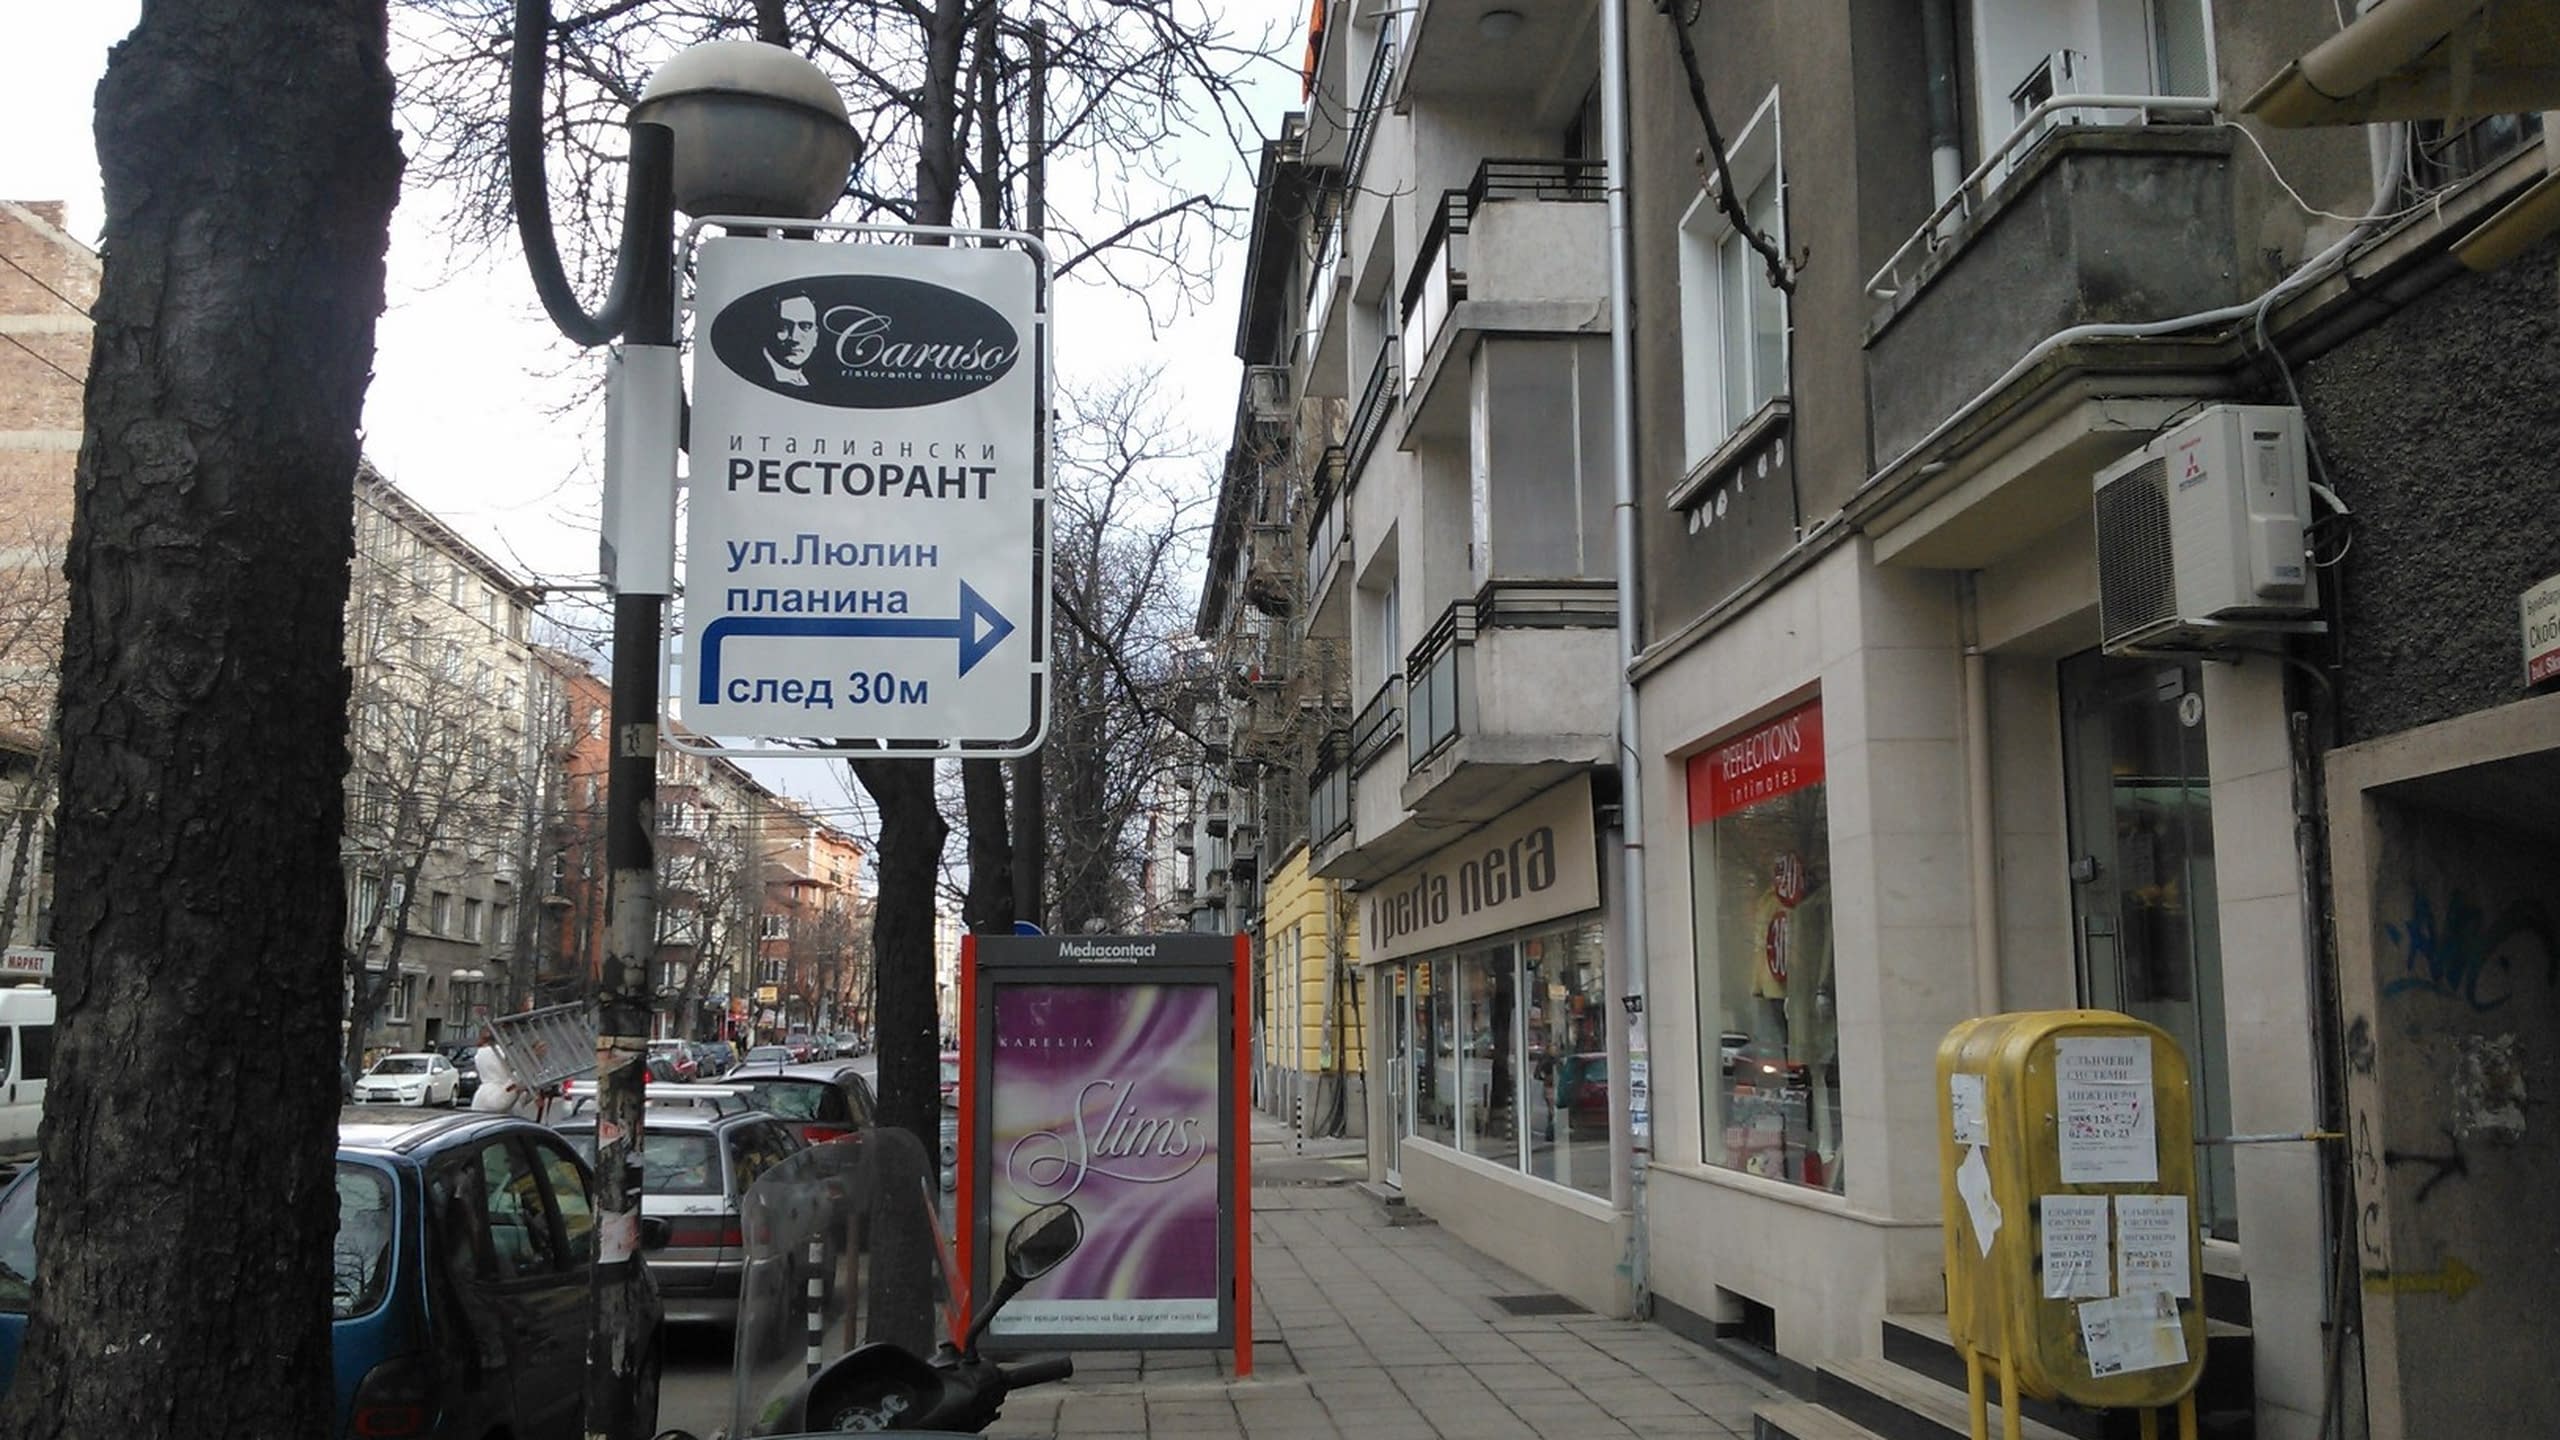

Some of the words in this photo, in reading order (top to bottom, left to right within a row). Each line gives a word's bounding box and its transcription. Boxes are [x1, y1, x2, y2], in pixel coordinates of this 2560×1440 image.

[823, 305, 1019, 370] Caruso
[841, 369, 923, 380] ristorante
[729, 435, 996, 460] италиански
[727, 458, 997, 500] РЕСТОРАНТ
[727, 533, 938, 573] ул.Люлин
[727, 587, 909, 614] планина
[727, 678, 834, 710] след
[848, 671, 929, 705] 30м
[1722, 716, 1801, 782] REFLECTIONS
[1383, 872, 1450, 949] perla
[1459, 825, 1557, 916] nera
[1059, 941, 1156, 958] Mediacontact
[1000, 1037, 1095, 1048] KARELIA
[1007, 1079, 1207, 1206] Slims
